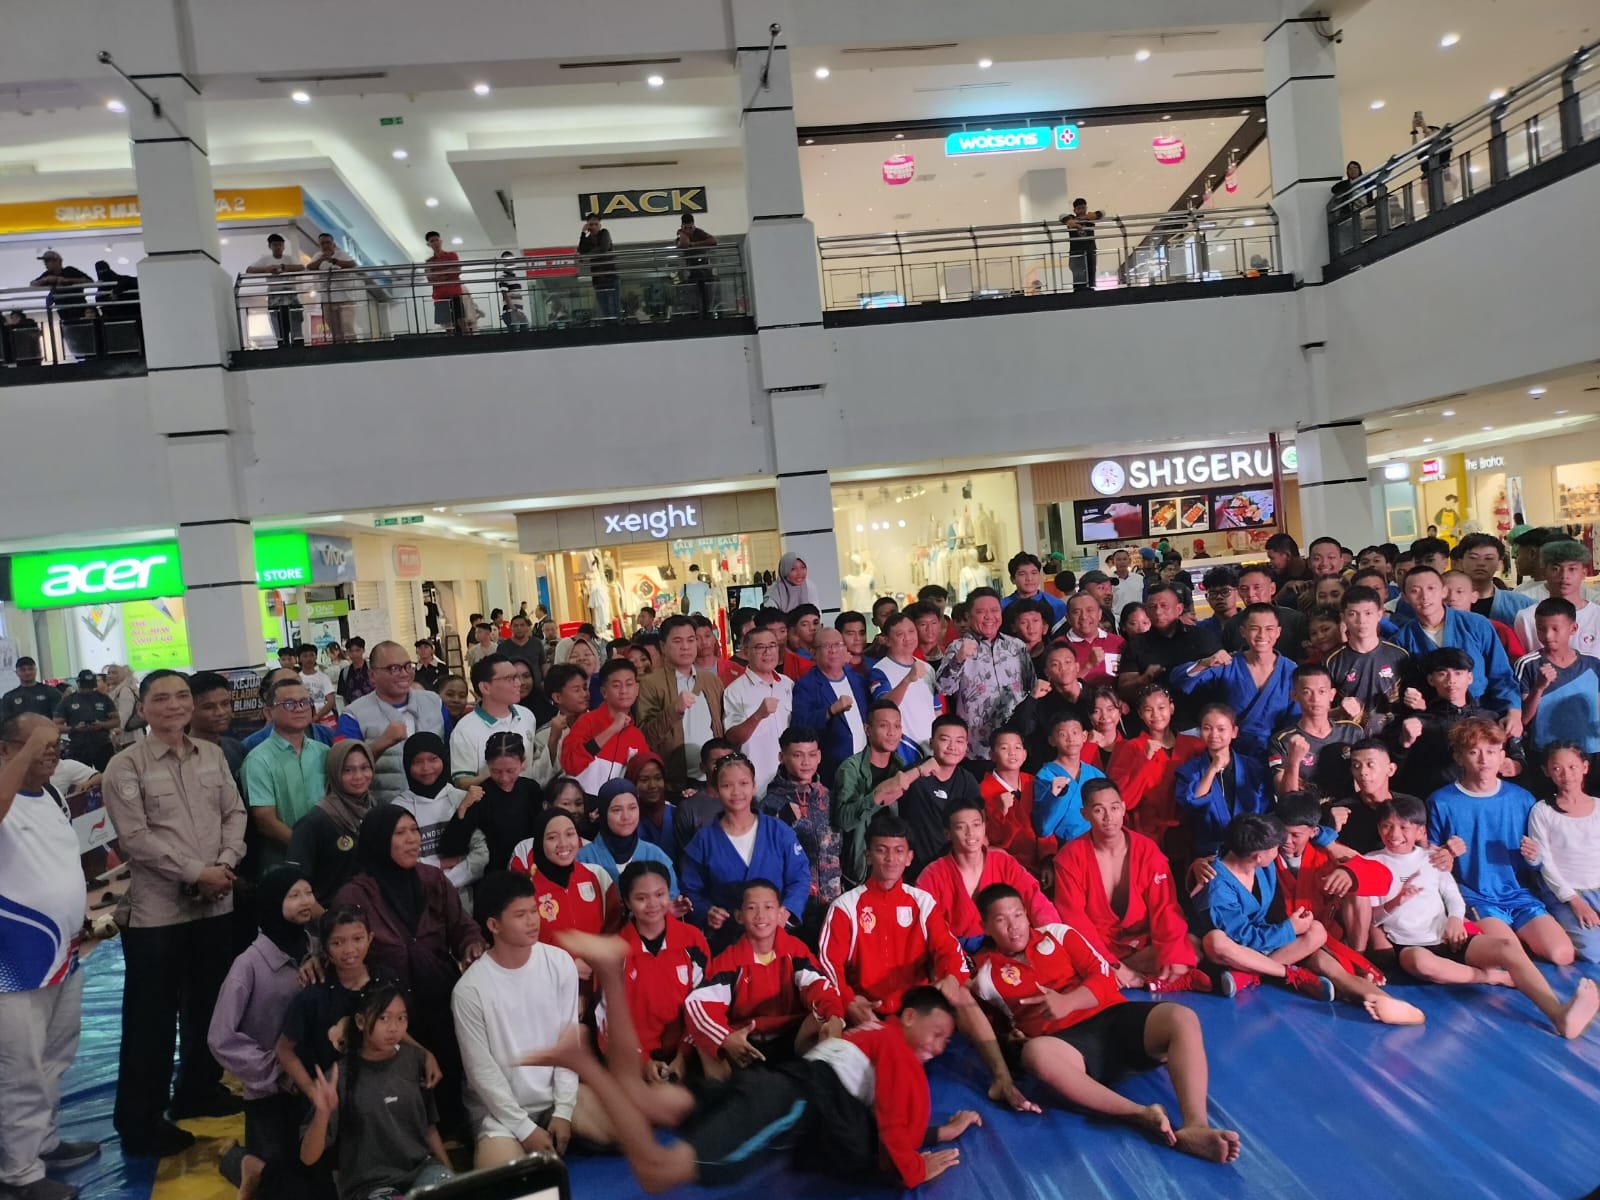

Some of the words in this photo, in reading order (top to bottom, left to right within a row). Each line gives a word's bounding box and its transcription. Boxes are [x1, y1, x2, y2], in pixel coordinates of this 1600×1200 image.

[958, 132, 1038, 150] watsons
[56, 204, 106, 221] SINAR
[234, 195, 246, 211] 2
[585, 188, 703, 217] JACK
[1128, 449, 1272, 489] SHIGERU
[604, 504, 697, 538] x-eight
[41, 555, 167, 597] acer
[263, 567, 303, 581] STORE
